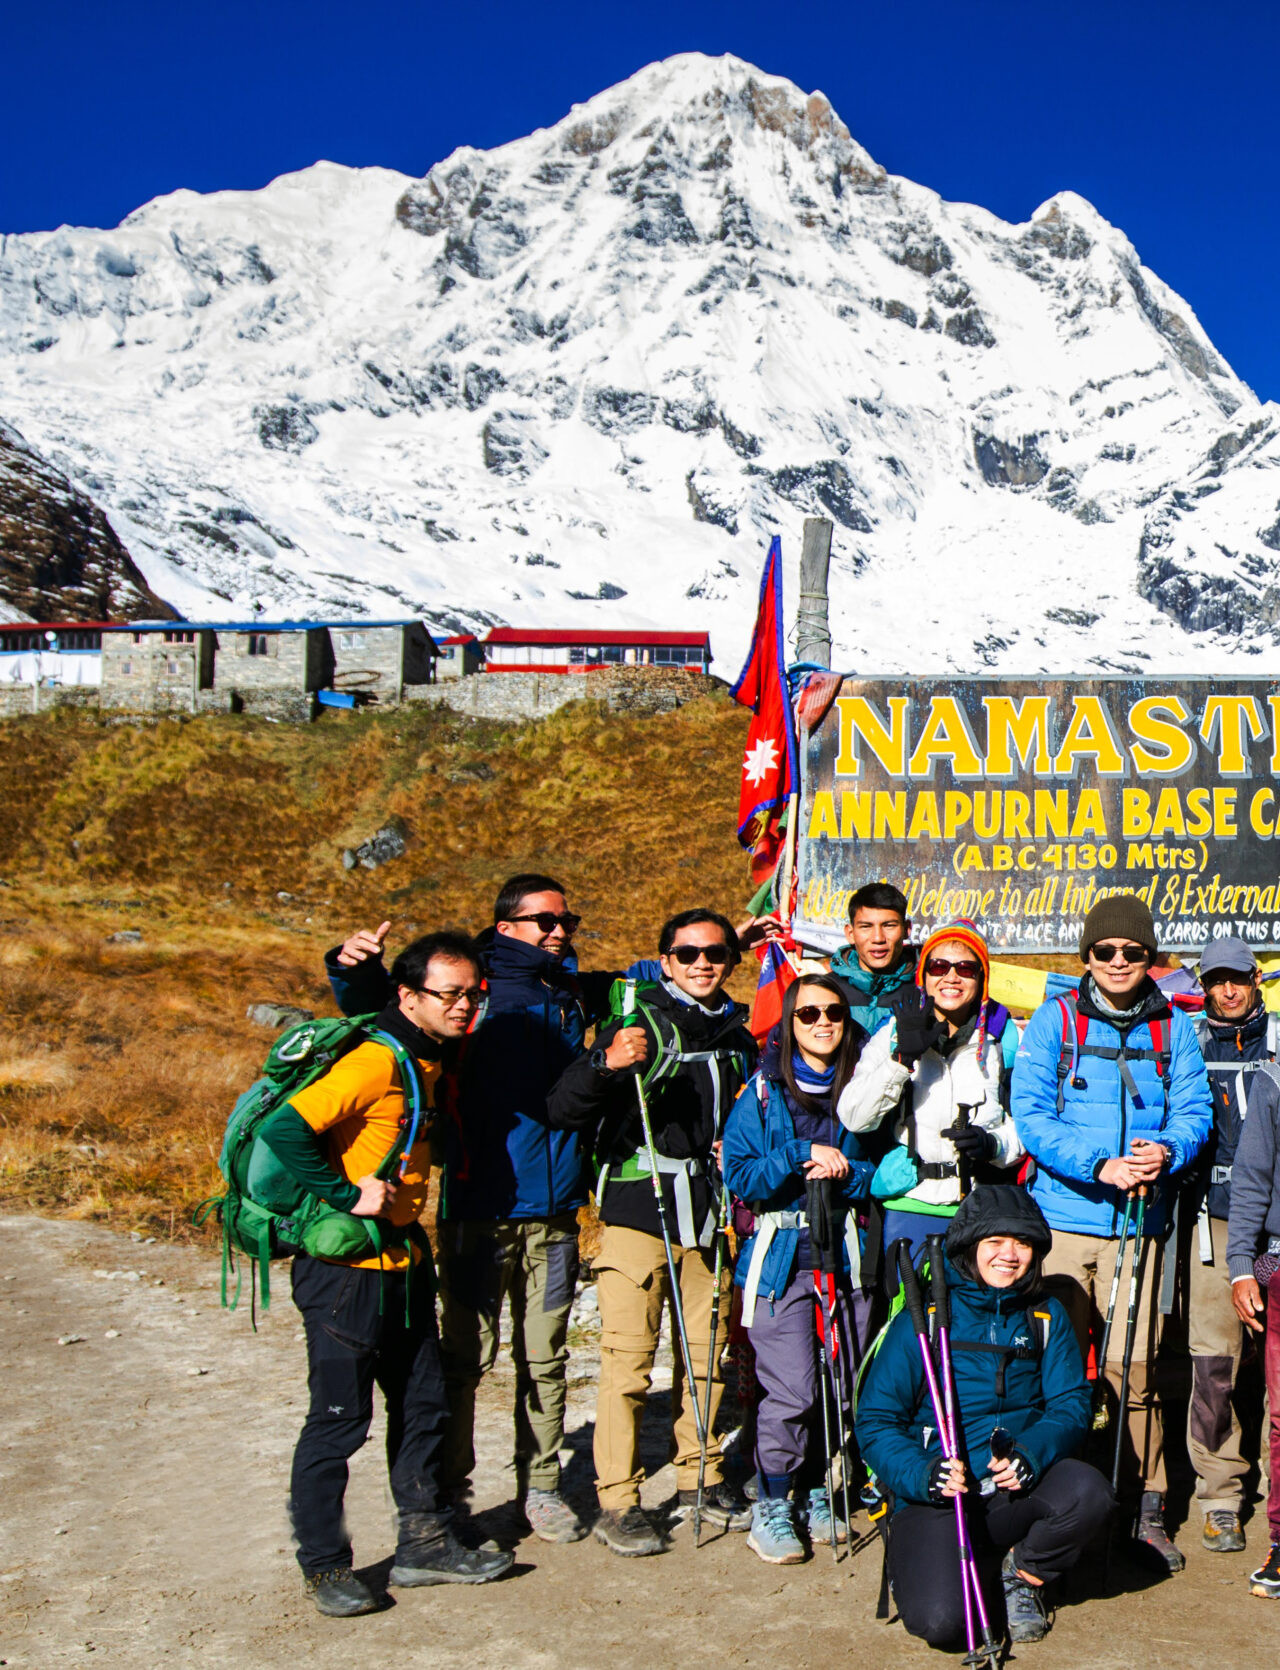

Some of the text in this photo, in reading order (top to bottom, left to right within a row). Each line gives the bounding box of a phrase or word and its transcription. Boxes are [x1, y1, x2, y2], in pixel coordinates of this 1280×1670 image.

[807, 788, 1108, 840] ANNAPURNA
[1122, 787, 1238, 839] BASE
[1126, 840, 1208, 872] Mtrs)
[803, 874, 888, 919] War
[902, 873, 995, 920] Welcome
[998, 876, 1022, 916] to
[1024, 875, 1059, 916] all
[1005, 922, 1054, 943] PLACE
[1212, 921, 1232, 940] ON
[1234, 920, 1269, 941] THIS
